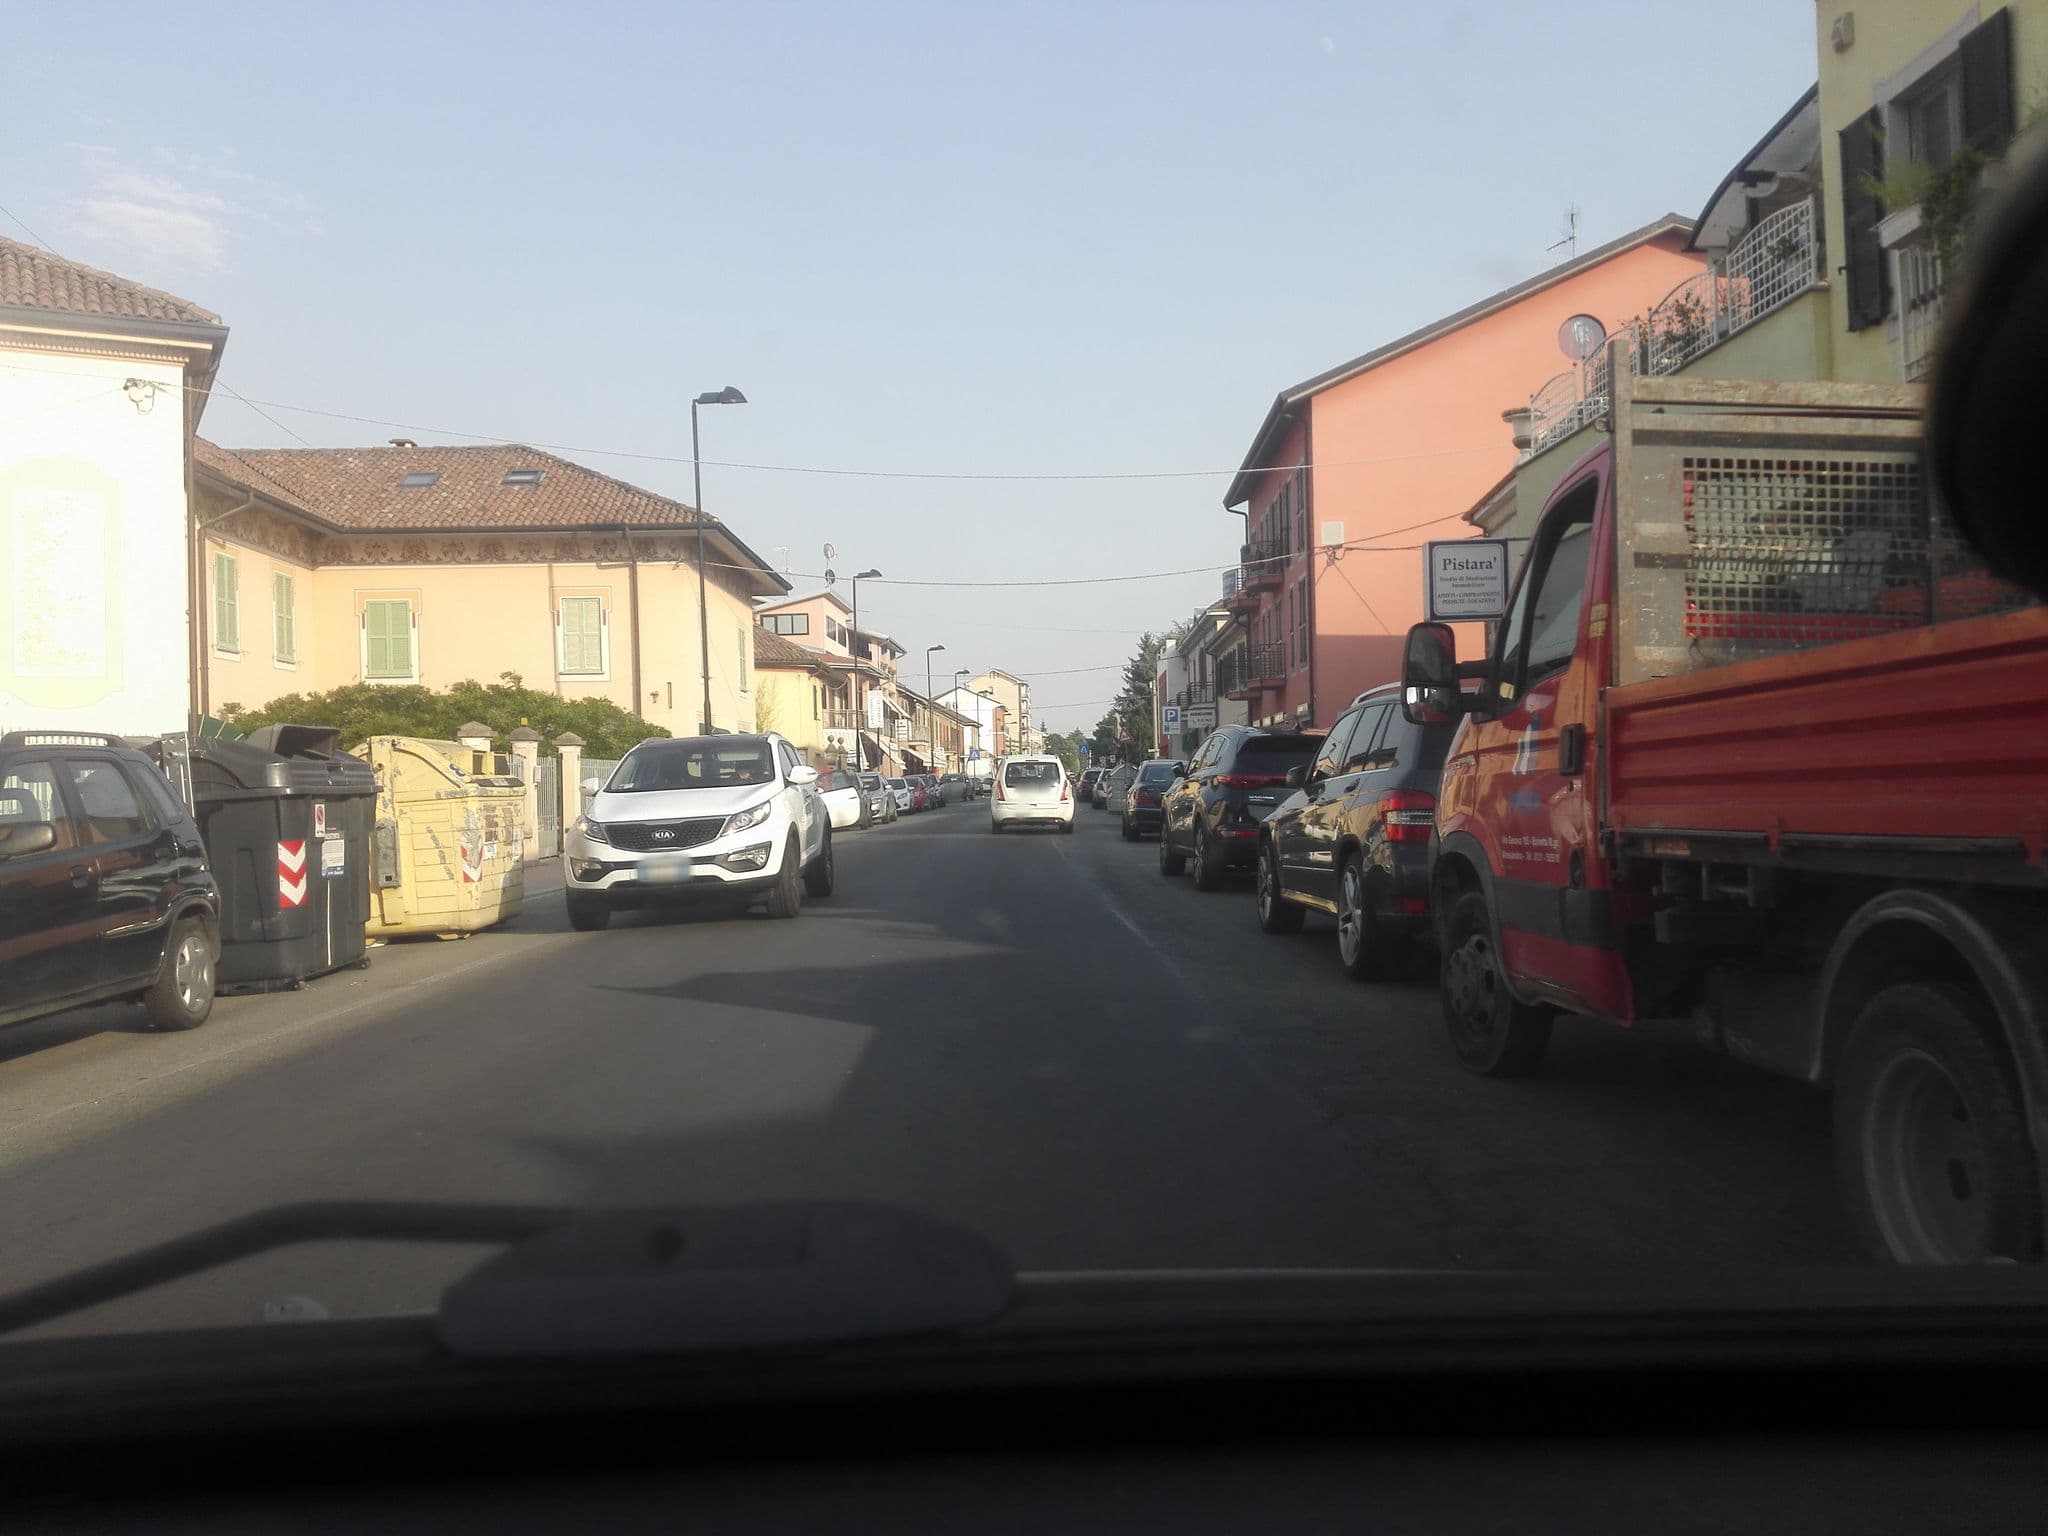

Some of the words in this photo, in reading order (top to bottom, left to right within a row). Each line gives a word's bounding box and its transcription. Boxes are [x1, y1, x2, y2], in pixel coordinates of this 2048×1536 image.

[1442, 556, 1496, 571] Pistara'
[1167, 710, 1176, 721] P
[655, 831, 670, 839] KIA
